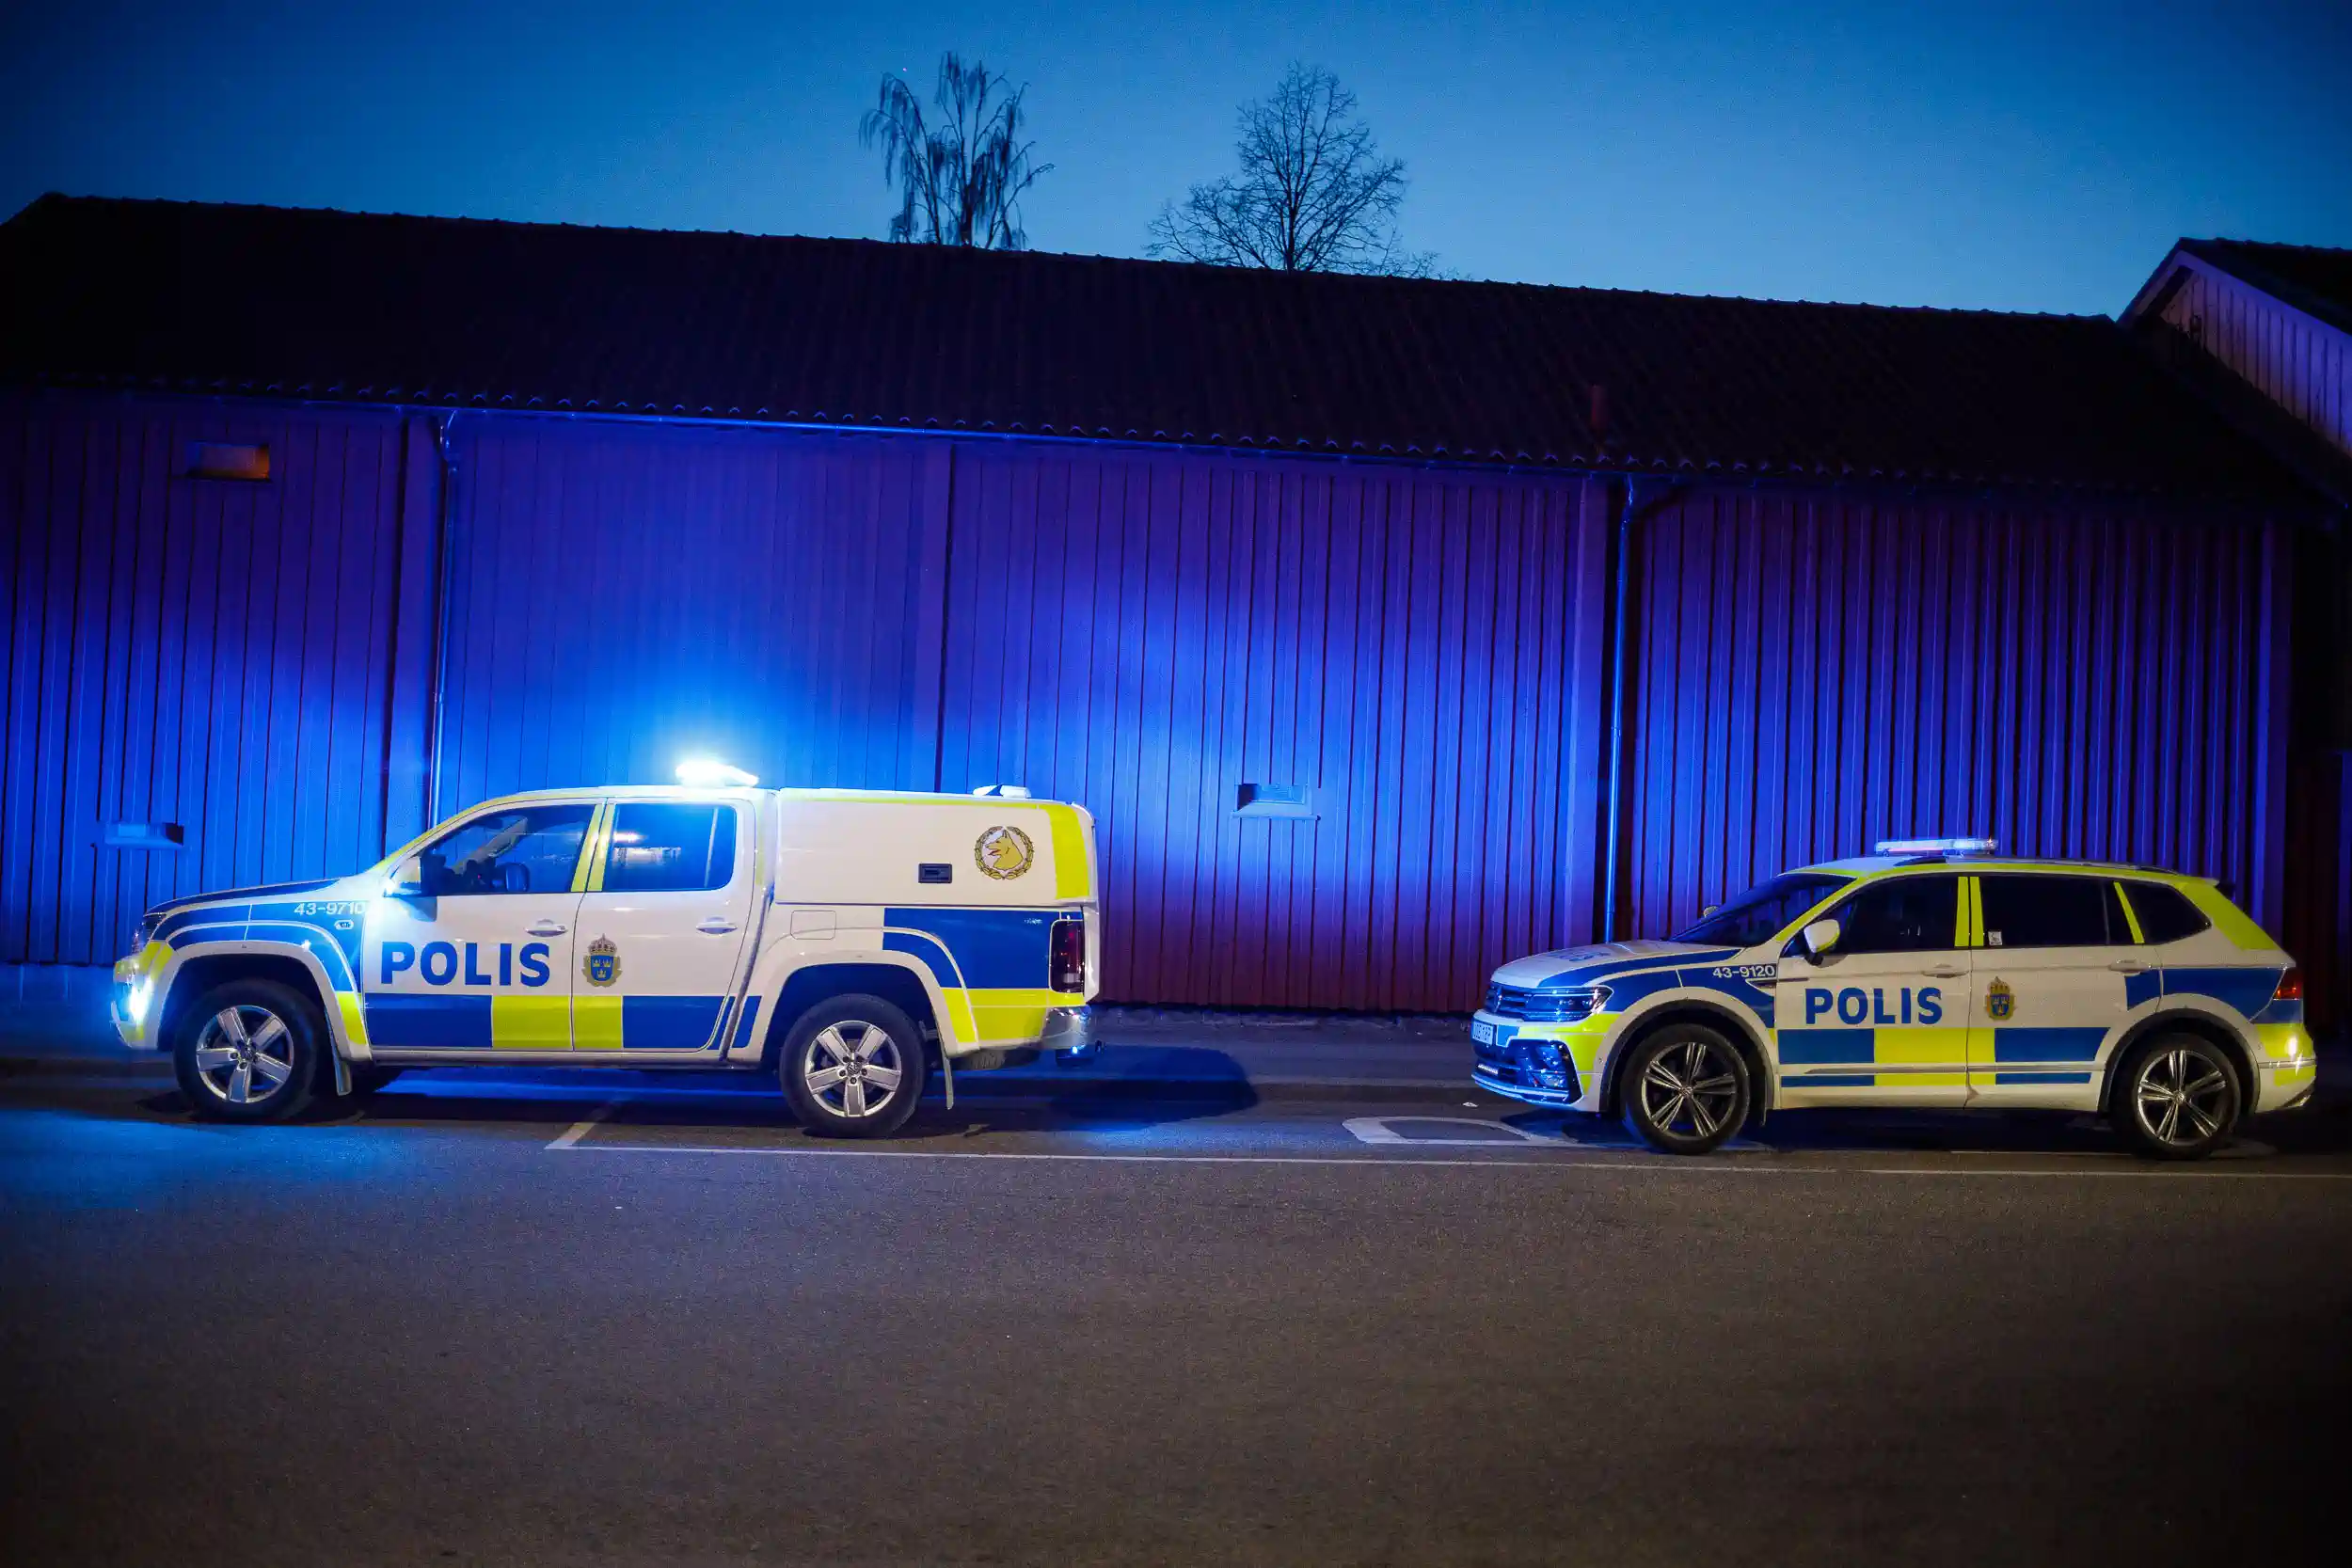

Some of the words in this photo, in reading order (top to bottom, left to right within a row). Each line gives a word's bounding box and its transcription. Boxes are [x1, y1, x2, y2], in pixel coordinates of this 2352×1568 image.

[294, 902, 365, 915] 43-9710
[381, 941, 550, 987] POLIS
[1712, 965, 1775, 978] 43-9120
[1804, 987, 1943, 1024] POLIS
